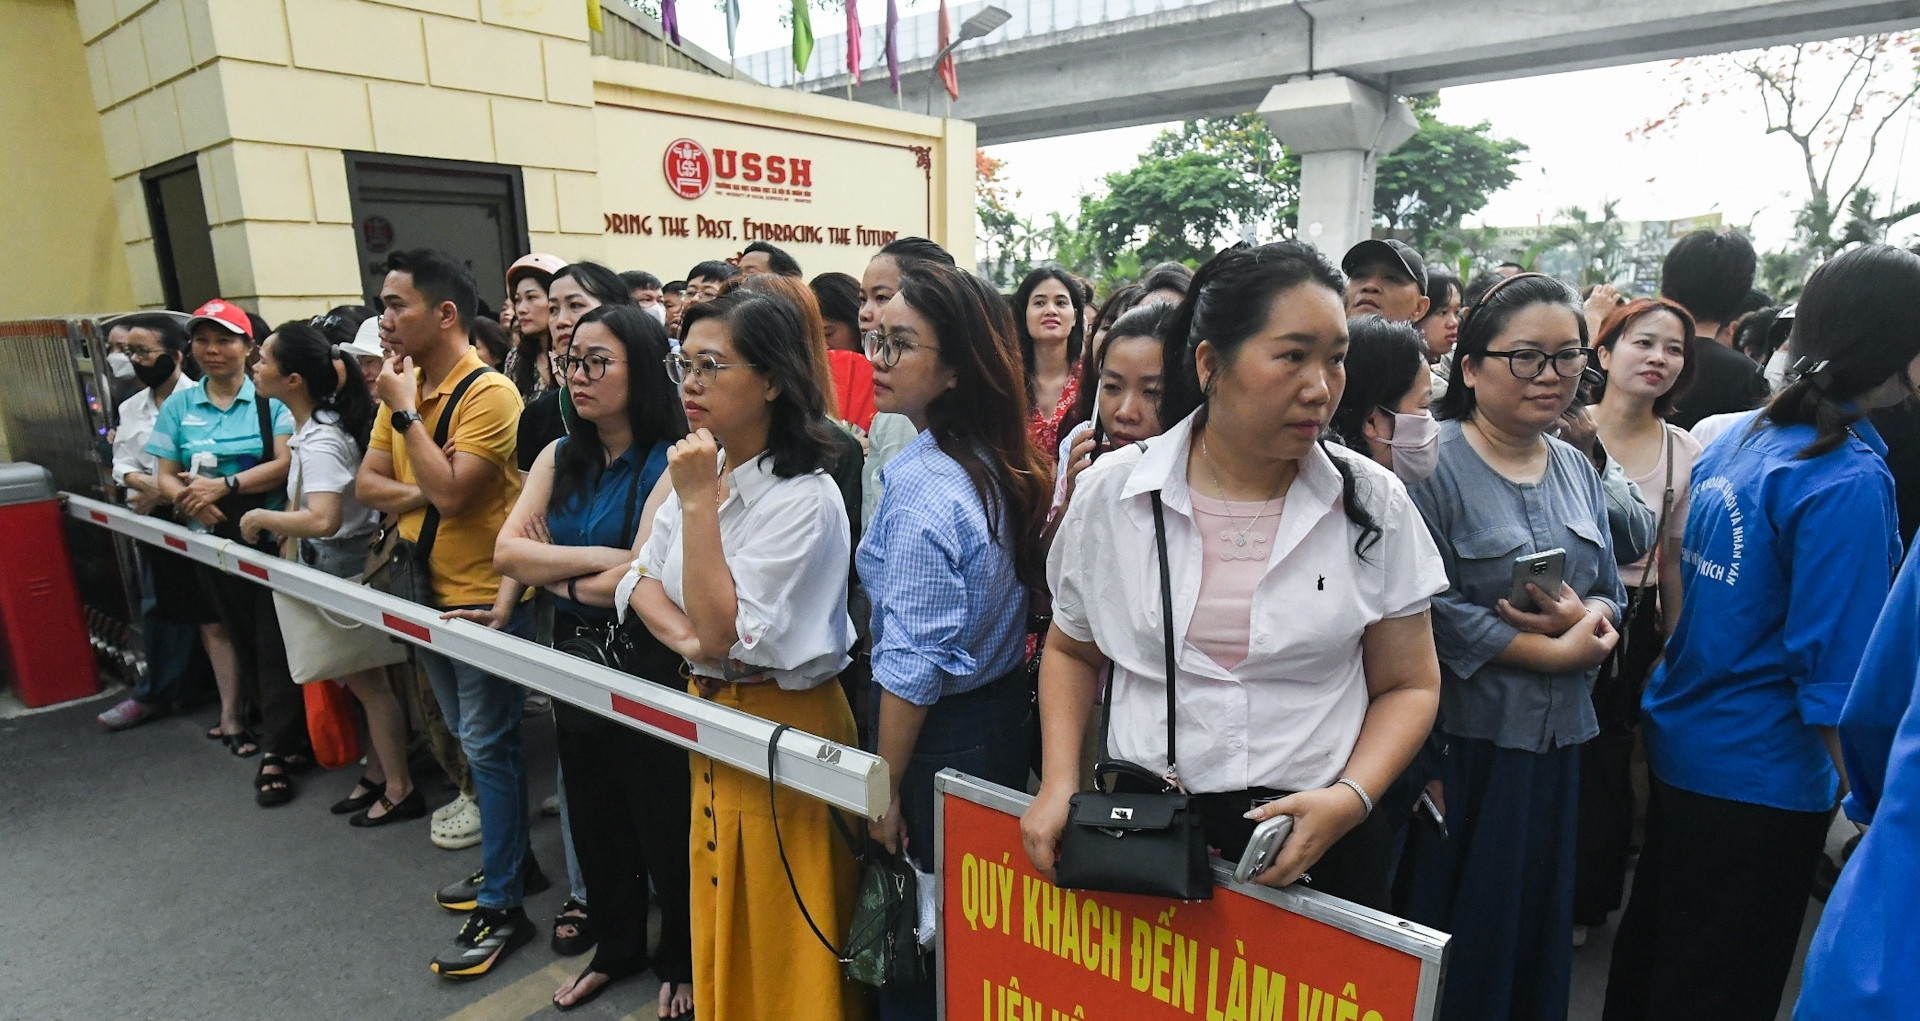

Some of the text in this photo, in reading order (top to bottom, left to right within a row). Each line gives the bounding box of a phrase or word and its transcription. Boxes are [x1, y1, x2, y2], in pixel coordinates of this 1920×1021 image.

[712, 148, 812, 187] USSH
[658, 216, 690, 238] THE
[743, 217, 823, 244] EMBRACING
[828, 226, 851, 245] THE
[1732, 526, 1744, 559] NHÂN
[1700, 560, 1725, 581] KÍCH
[962, 852, 1014, 936] QUÝ
[1130, 906, 1198, 1015] ĐẾN
[1206, 938, 1287, 1021] LÀM
